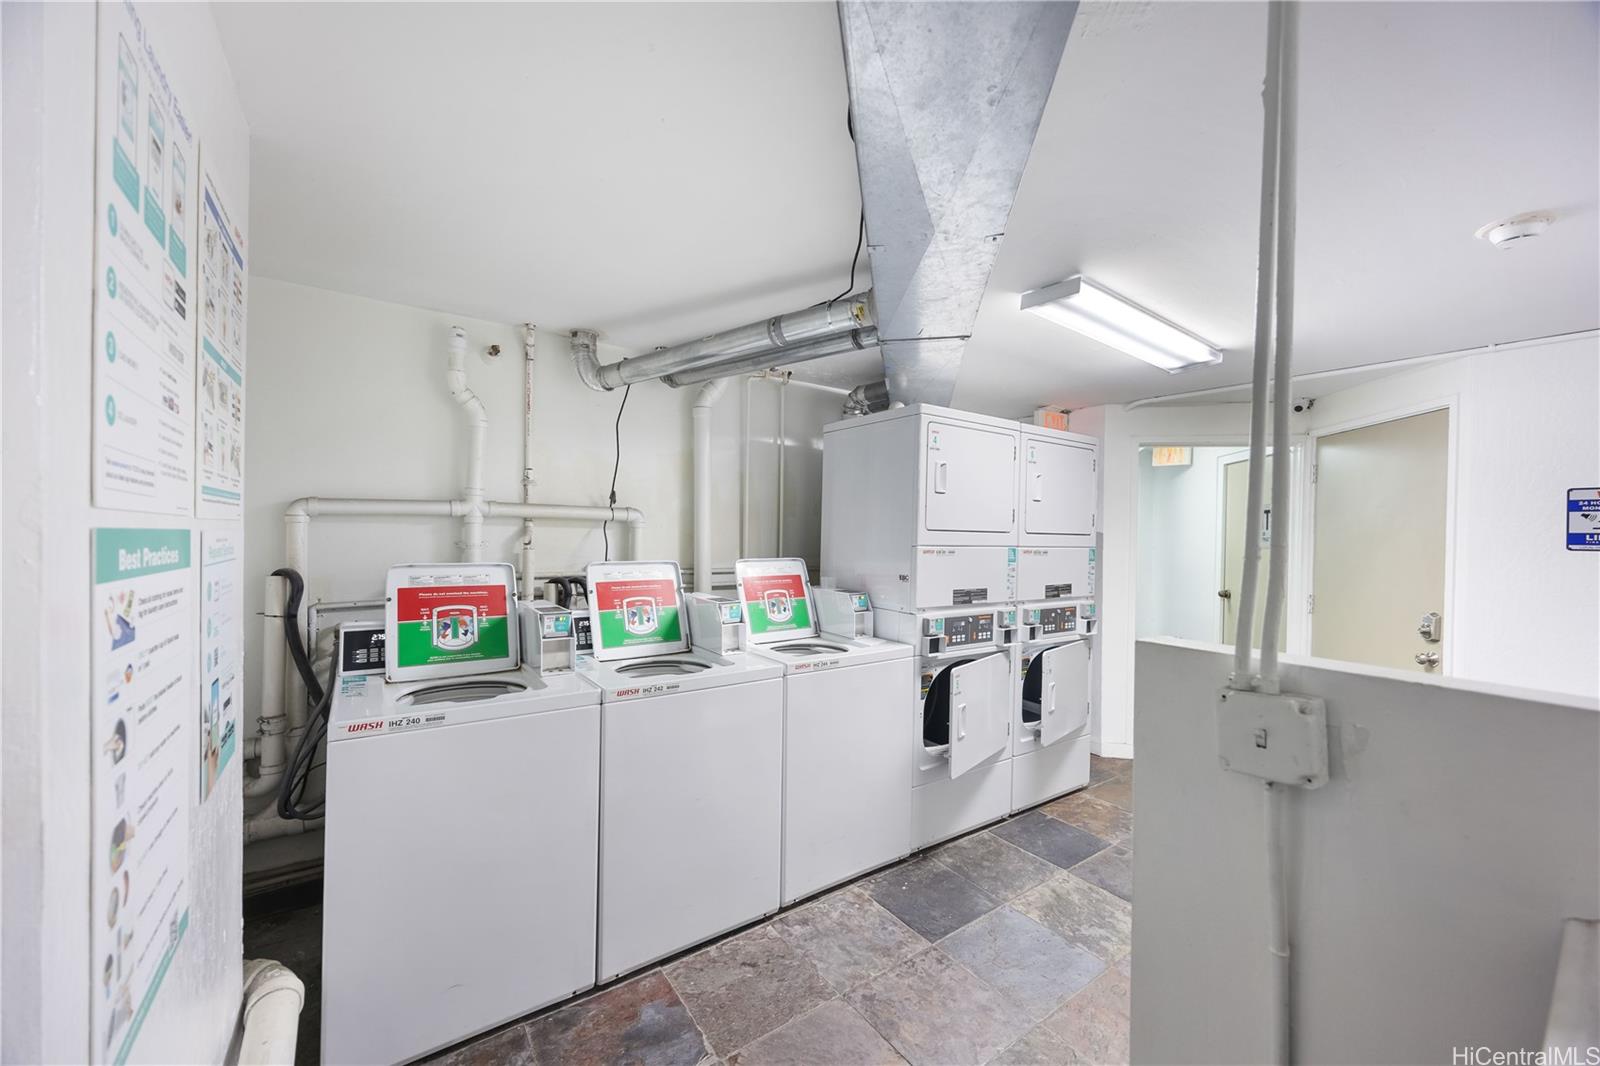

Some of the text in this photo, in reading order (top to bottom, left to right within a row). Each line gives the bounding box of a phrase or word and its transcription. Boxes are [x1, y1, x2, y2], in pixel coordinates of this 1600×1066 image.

[118, 545, 179, 571] Best Practices
[616, 688, 640, 697] WASH
[347, 720, 384, 732] WASH
[388, 719, 404, 728] IHZ
[406, 717, 421, 726] 240
